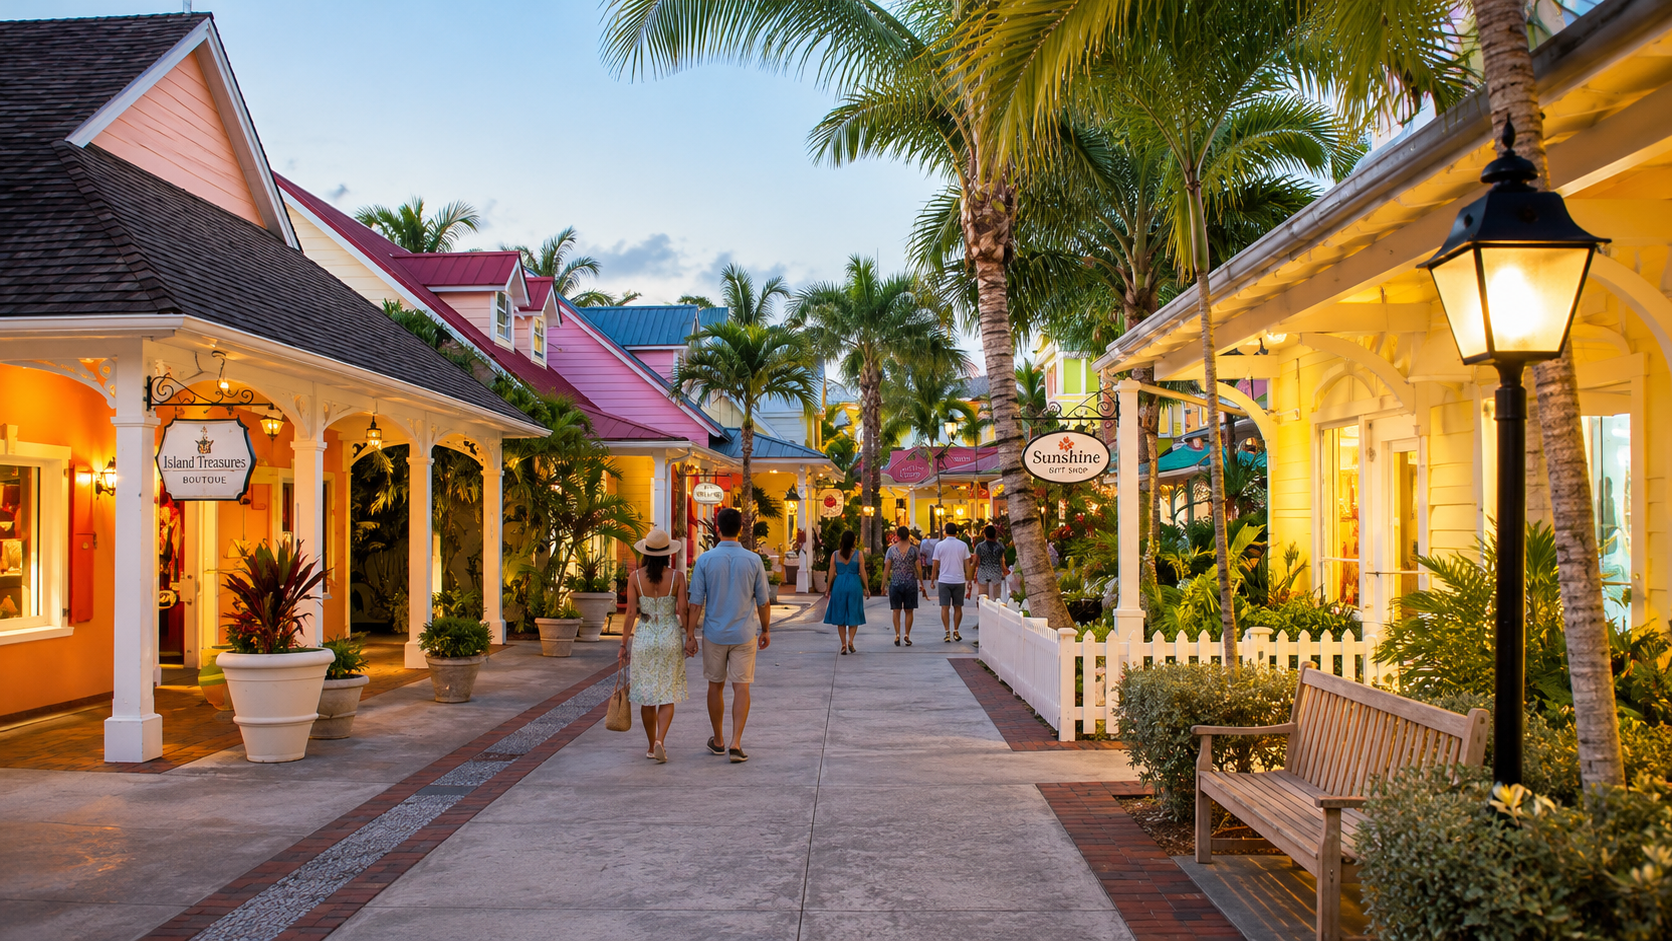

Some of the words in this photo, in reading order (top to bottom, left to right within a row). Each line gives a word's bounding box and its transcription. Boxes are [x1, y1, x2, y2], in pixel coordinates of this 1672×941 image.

[163, 455, 195, 469] Island
[196, 455, 247, 469] Treasures
[1032, 450, 1101, 464] Sunshine
